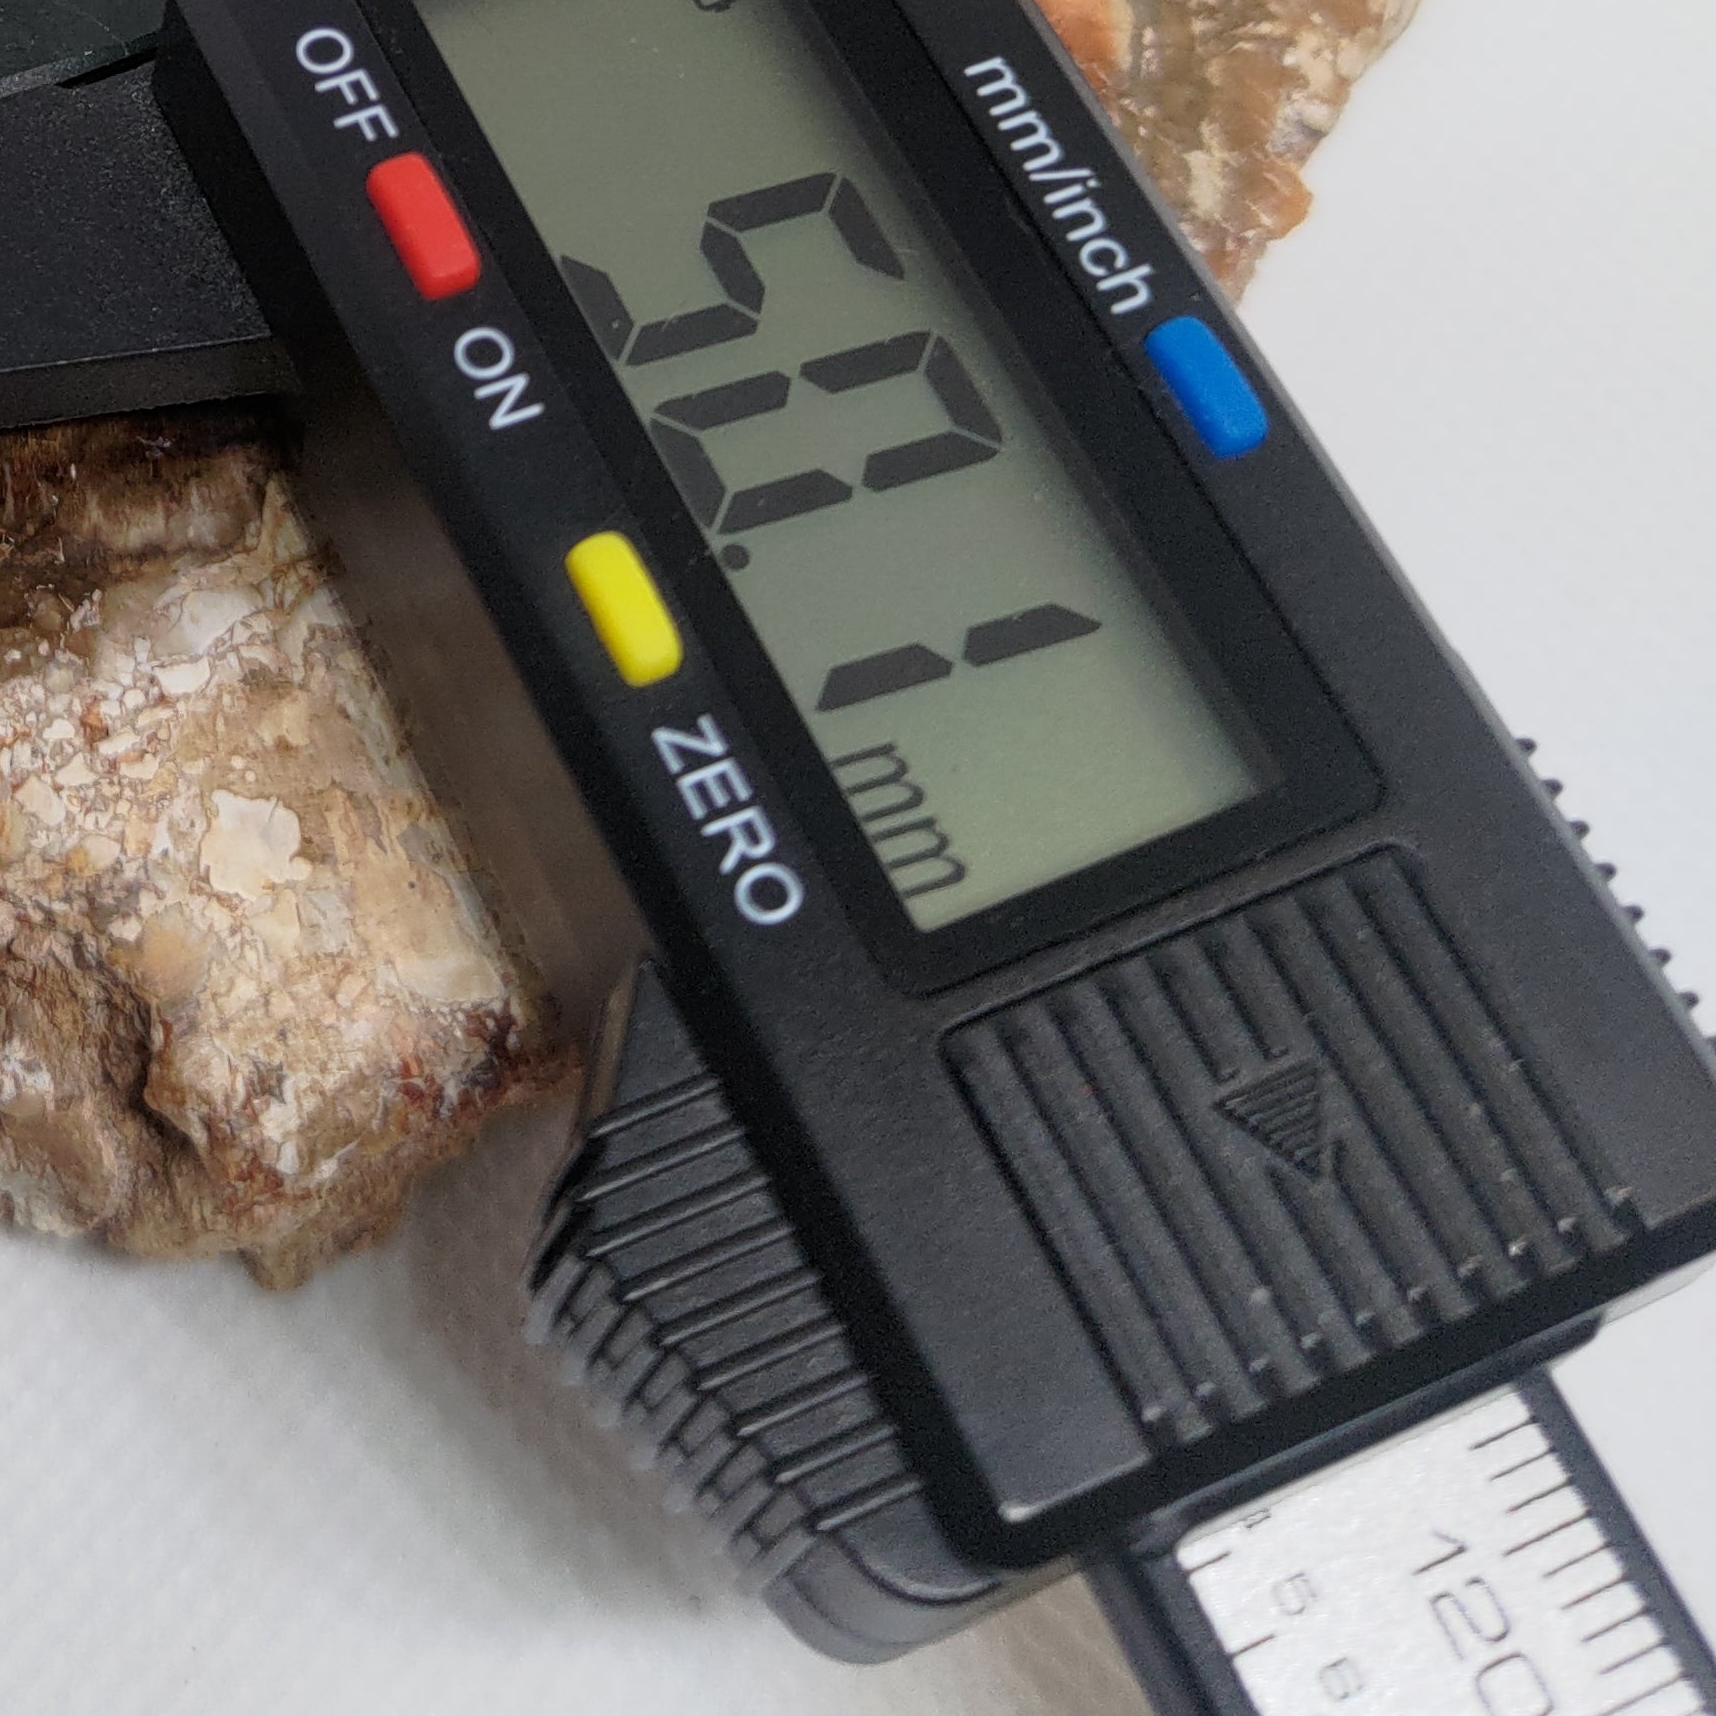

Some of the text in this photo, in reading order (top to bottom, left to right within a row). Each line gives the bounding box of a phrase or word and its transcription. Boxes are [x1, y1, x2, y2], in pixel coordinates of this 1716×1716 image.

[295, 27, 399, 142] OFF
[964, 56, 1153, 316] mm/inch
[453, 326, 545, 431] ON
[560, 171, 1103, 901] 50.1 mm
[651, 713, 805, 926] ZERO
[1271, 1572, 1318, 1616] 5
[1412, 1529, 1554, 1716] 120
[1319, 1657, 1364, 1701] 6
